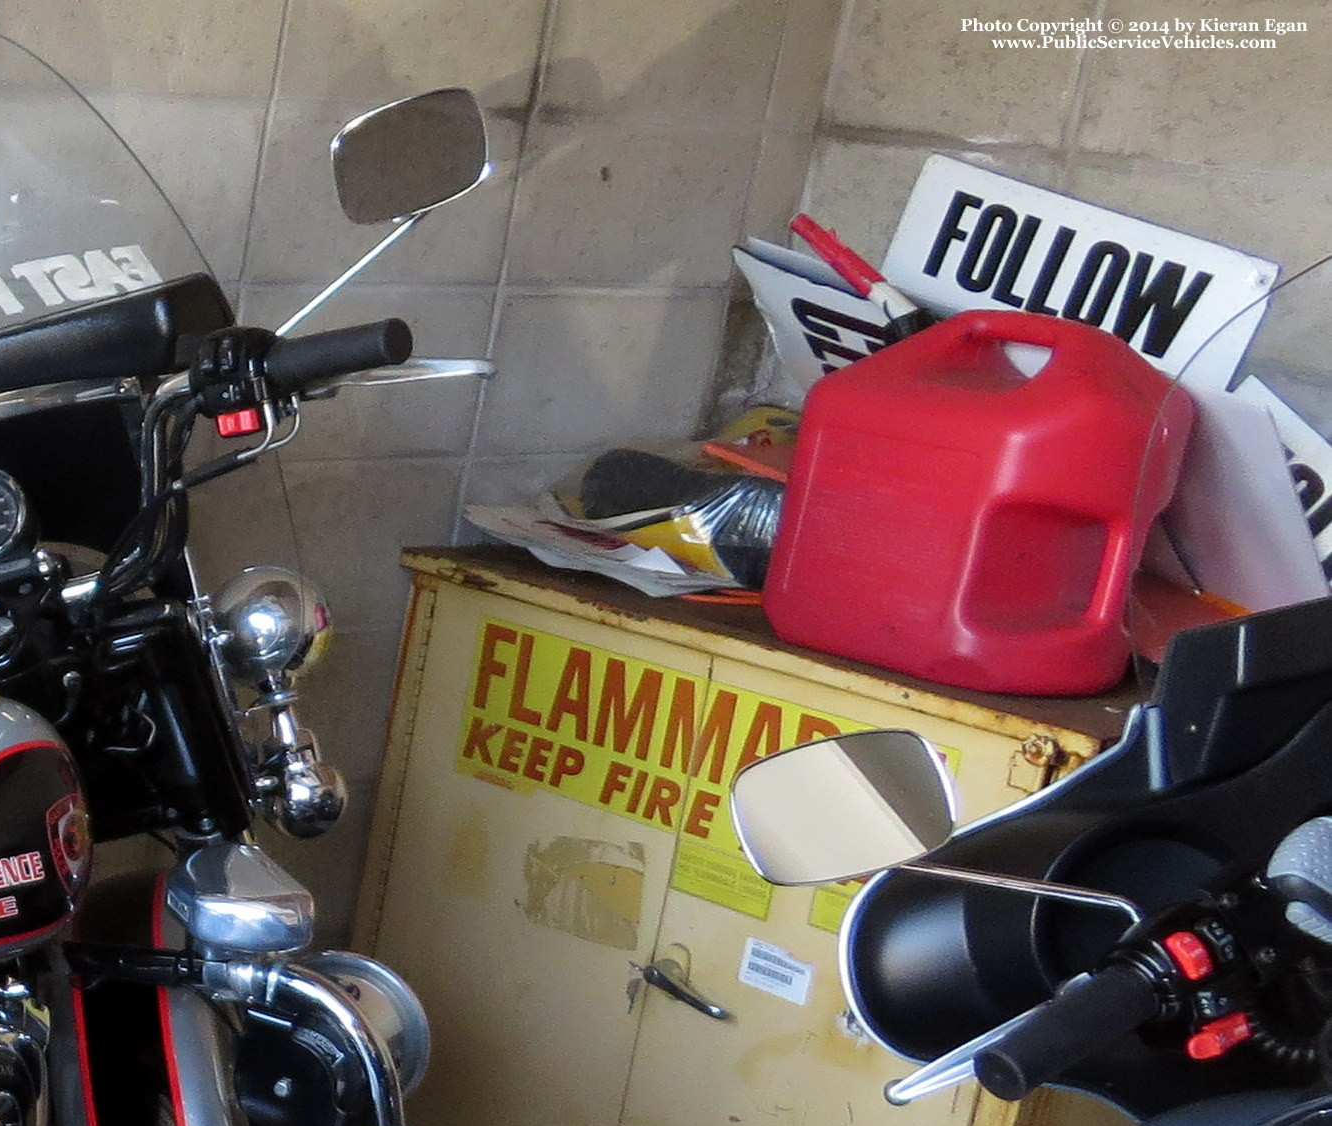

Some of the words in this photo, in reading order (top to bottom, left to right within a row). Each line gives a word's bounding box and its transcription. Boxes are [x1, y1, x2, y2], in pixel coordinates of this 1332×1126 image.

[923, 190, 1213, 359] FOLLOW
[462, 716, 585, 788] KEEP
[598, 760, 722, 839] FIRE
[473, 622, 843, 785] FLAMMA
